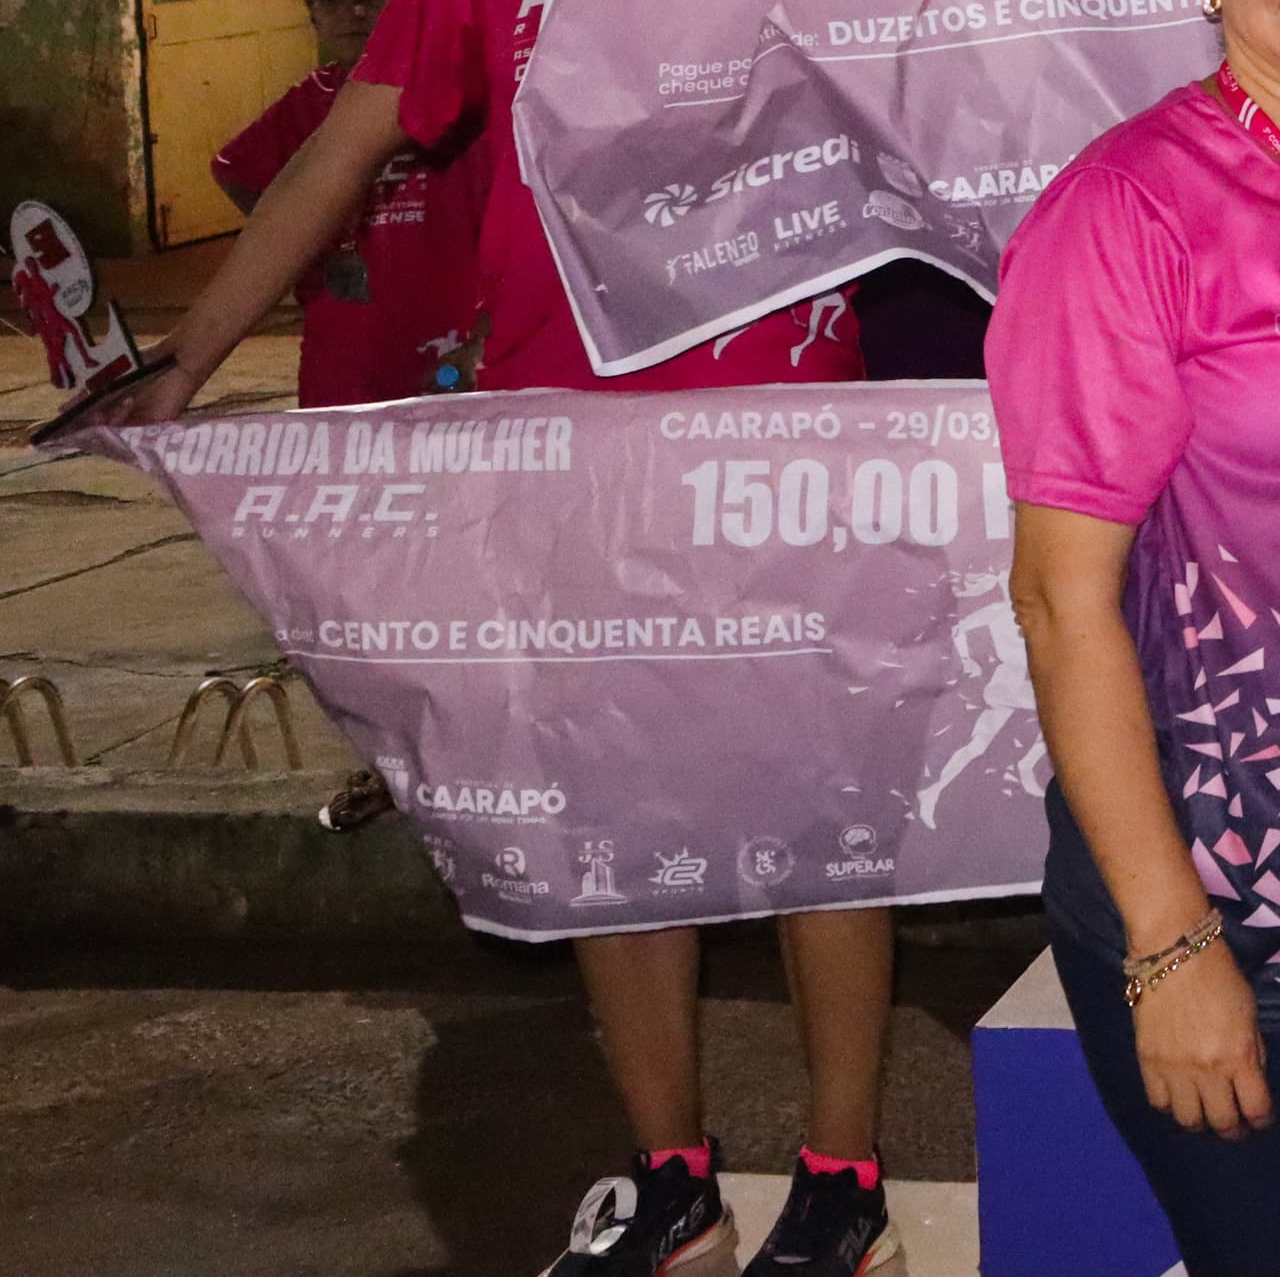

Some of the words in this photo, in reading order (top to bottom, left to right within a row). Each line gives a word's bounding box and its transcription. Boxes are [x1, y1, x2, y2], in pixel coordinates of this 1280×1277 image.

[995, 0, 1013, 25] E
[658, 59, 723, 83] Pague
[658, 75, 735, 101] cheque
[773, 199, 841, 241] LIVE
[659, 403, 842, 441] CAARAPÓ
[343, 421, 397, 476] DA
[408, 415, 574, 474] MULHER
[232, 483, 438, 524] A.A.C.
[680, 458, 959, 554] 150,00
[231, 526, 440, 540] RUNNERS
[318, 620, 441, 652] CENTO
[449, 620, 468, 650] E
[475, 616, 706, 654] CINQUENTA
[714, 611, 827, 647] REAIS
[416, 781, 567, 815] CAARAPÓ
[825, 858, 895, 877] SUPERAR
